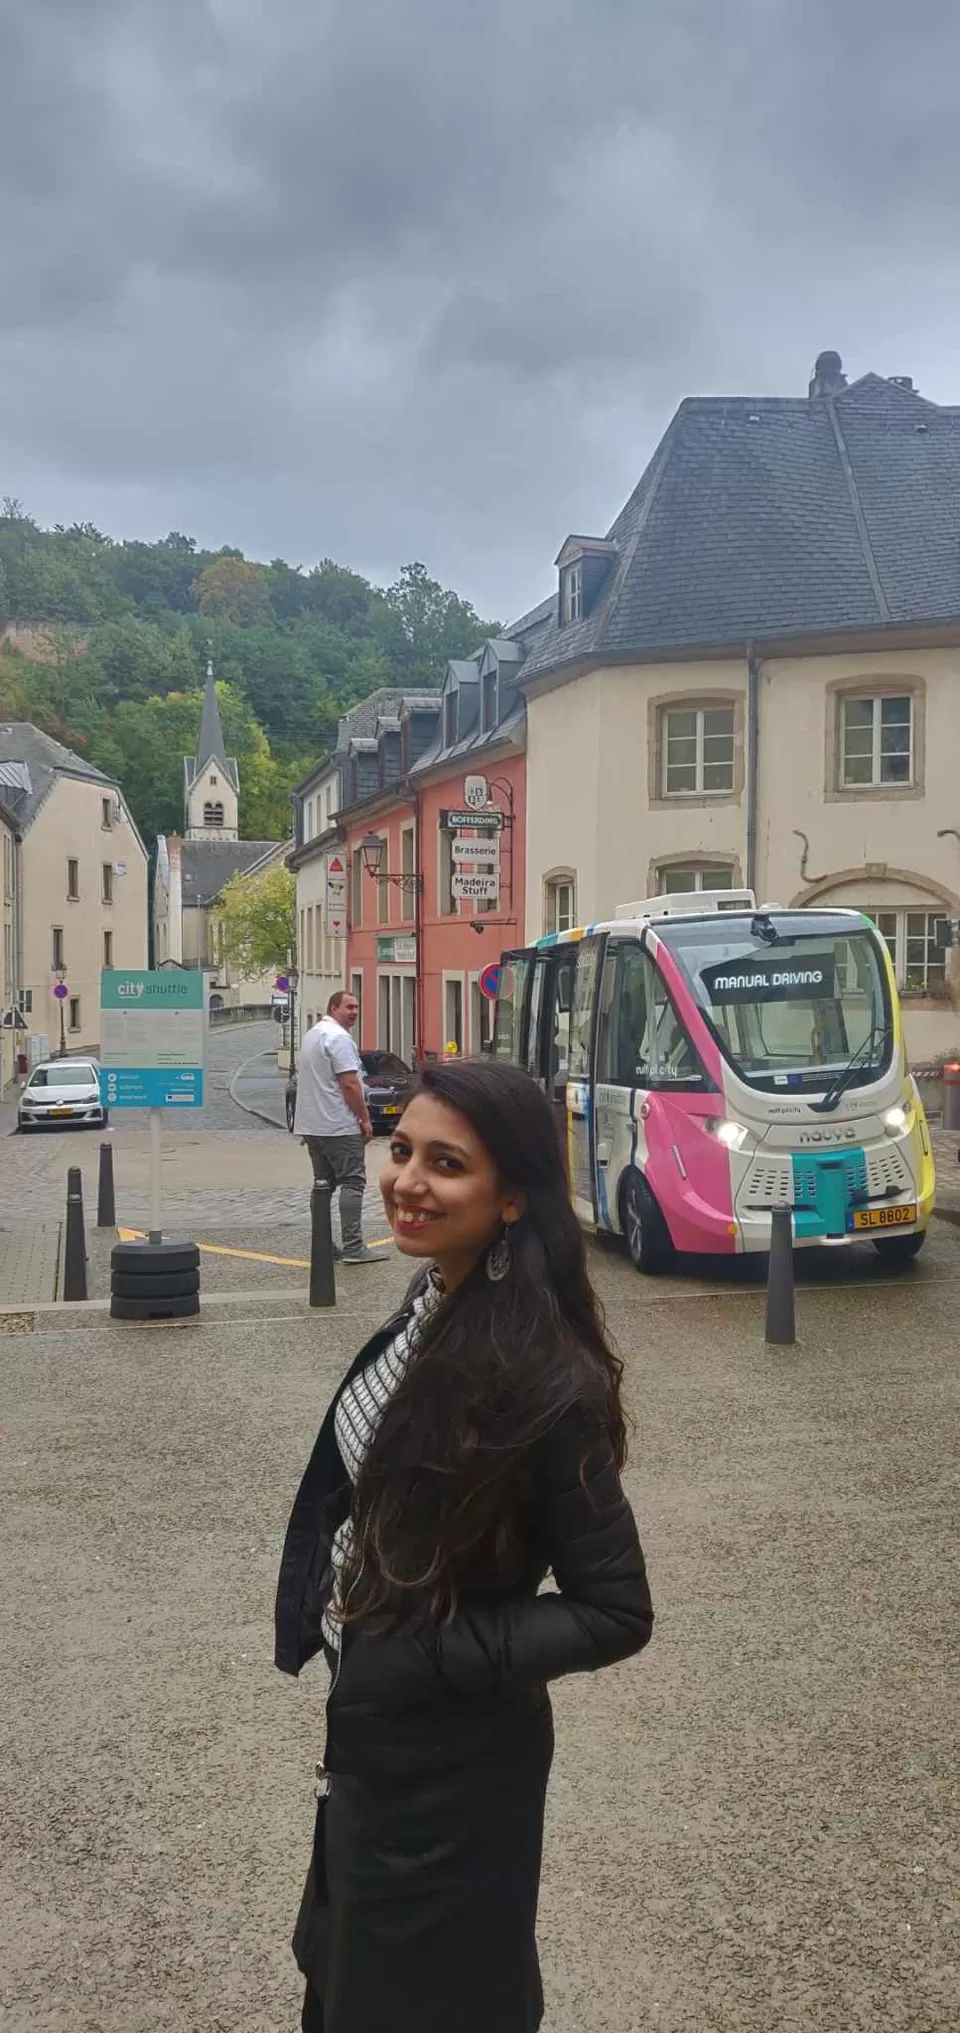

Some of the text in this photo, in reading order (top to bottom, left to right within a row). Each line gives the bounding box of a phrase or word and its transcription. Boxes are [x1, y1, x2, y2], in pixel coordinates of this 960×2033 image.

[454, 845, 496, 856] Brasserie
[454, 877, 496, 887] Madeira
[462, 886, 489, 895] Stuff
[714, 970, 823, 990] MANUAL DRIVING
[117, 980, 188, 999] city shuttle
[860, 1207, 910, 1226] SL 8802
